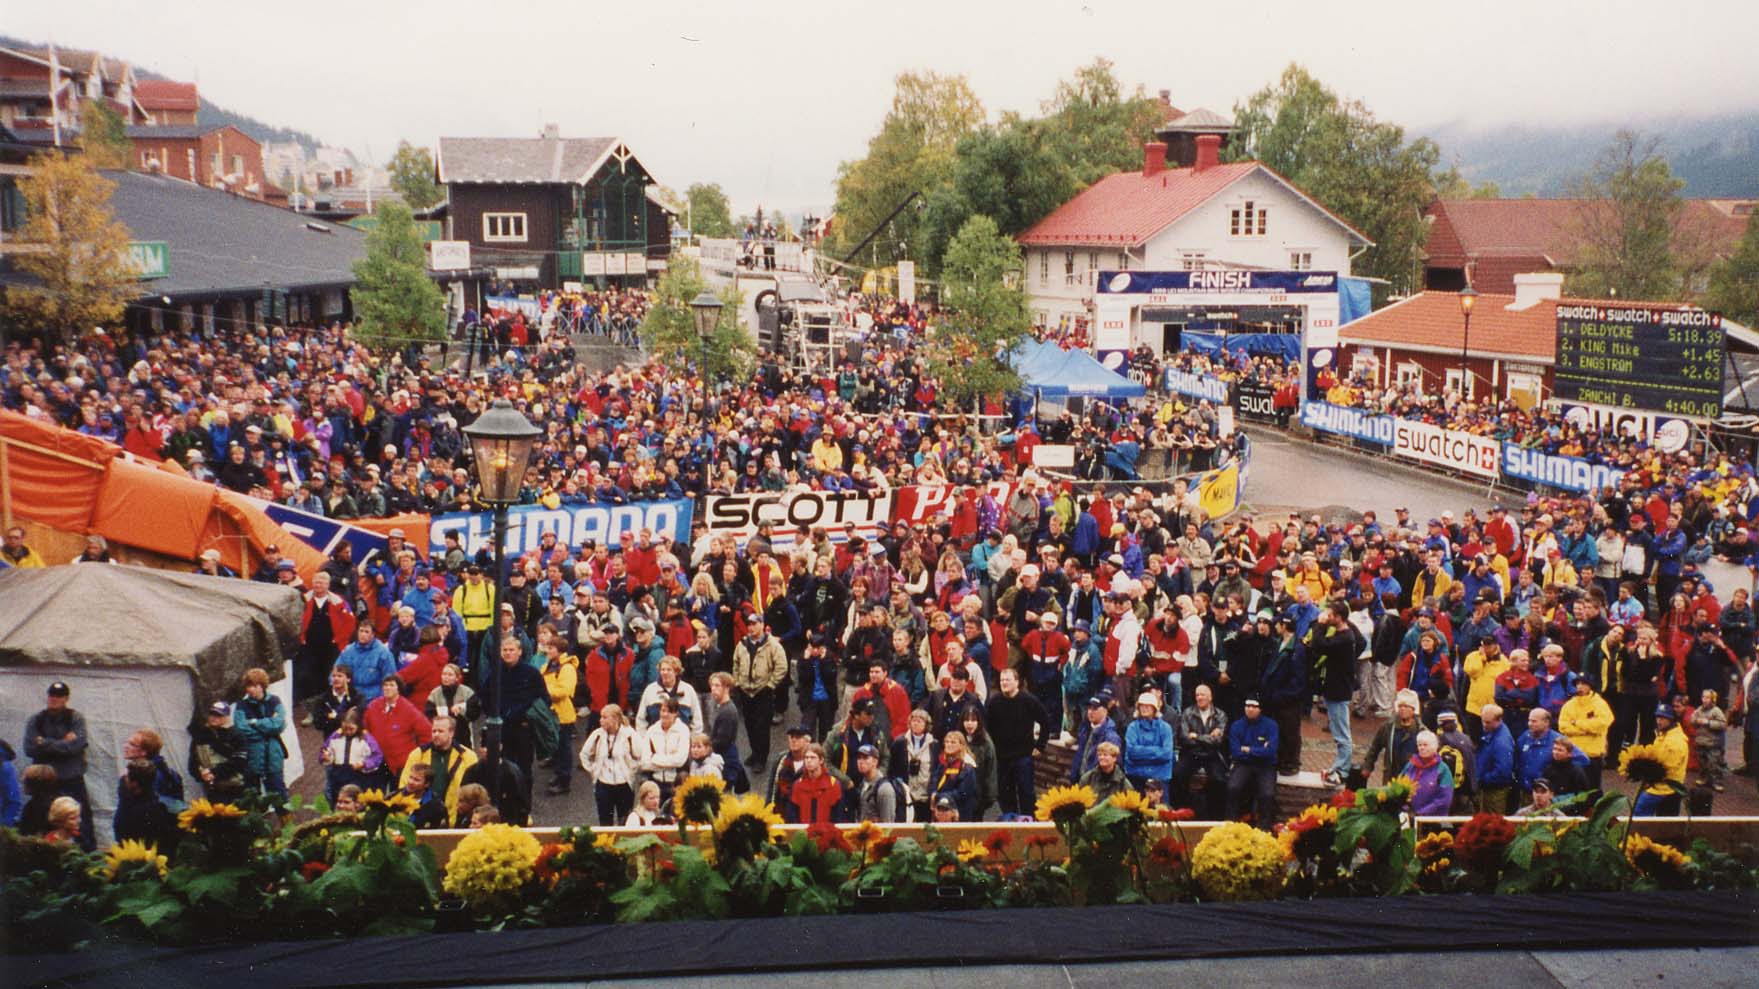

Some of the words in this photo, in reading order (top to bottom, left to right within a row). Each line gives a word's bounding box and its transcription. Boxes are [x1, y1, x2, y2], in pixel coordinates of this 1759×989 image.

[1189, 271, 1251, 288] FINISH
[1556, 305, 1598, 319] swatch
[1606, 308, 1651, 323] swatch
[1662, 311, 1711, 326] swatch
[1668, 327, 1722, 344] 5:18.39
[1561, 337, 1573, 350] 2.
[1580, 339, 1606, 354] KING
[1612, 341, 1640, 357] Mike
[1682, 347, 1721, 363] +1.45
[1561, 353, 1572, 367] 3.
[1681, 364, 1720, 381] +2.63
[1239, 395, 1277, 415] swat
[1579, 387, 1617, 405] ZANCHI
[1623, 394, 1636, 407] B.
[1665, 400, 1718, 417] 4:40.00
[1303, 401, 1393, 441] SHIMANO
[1594, 409, 1648, 437] UCI
[1397, 427, 1479, 465] swatch
[711, 492, 887, 528] SCOTT
[430, 503, 677, 560] SHIMANO
